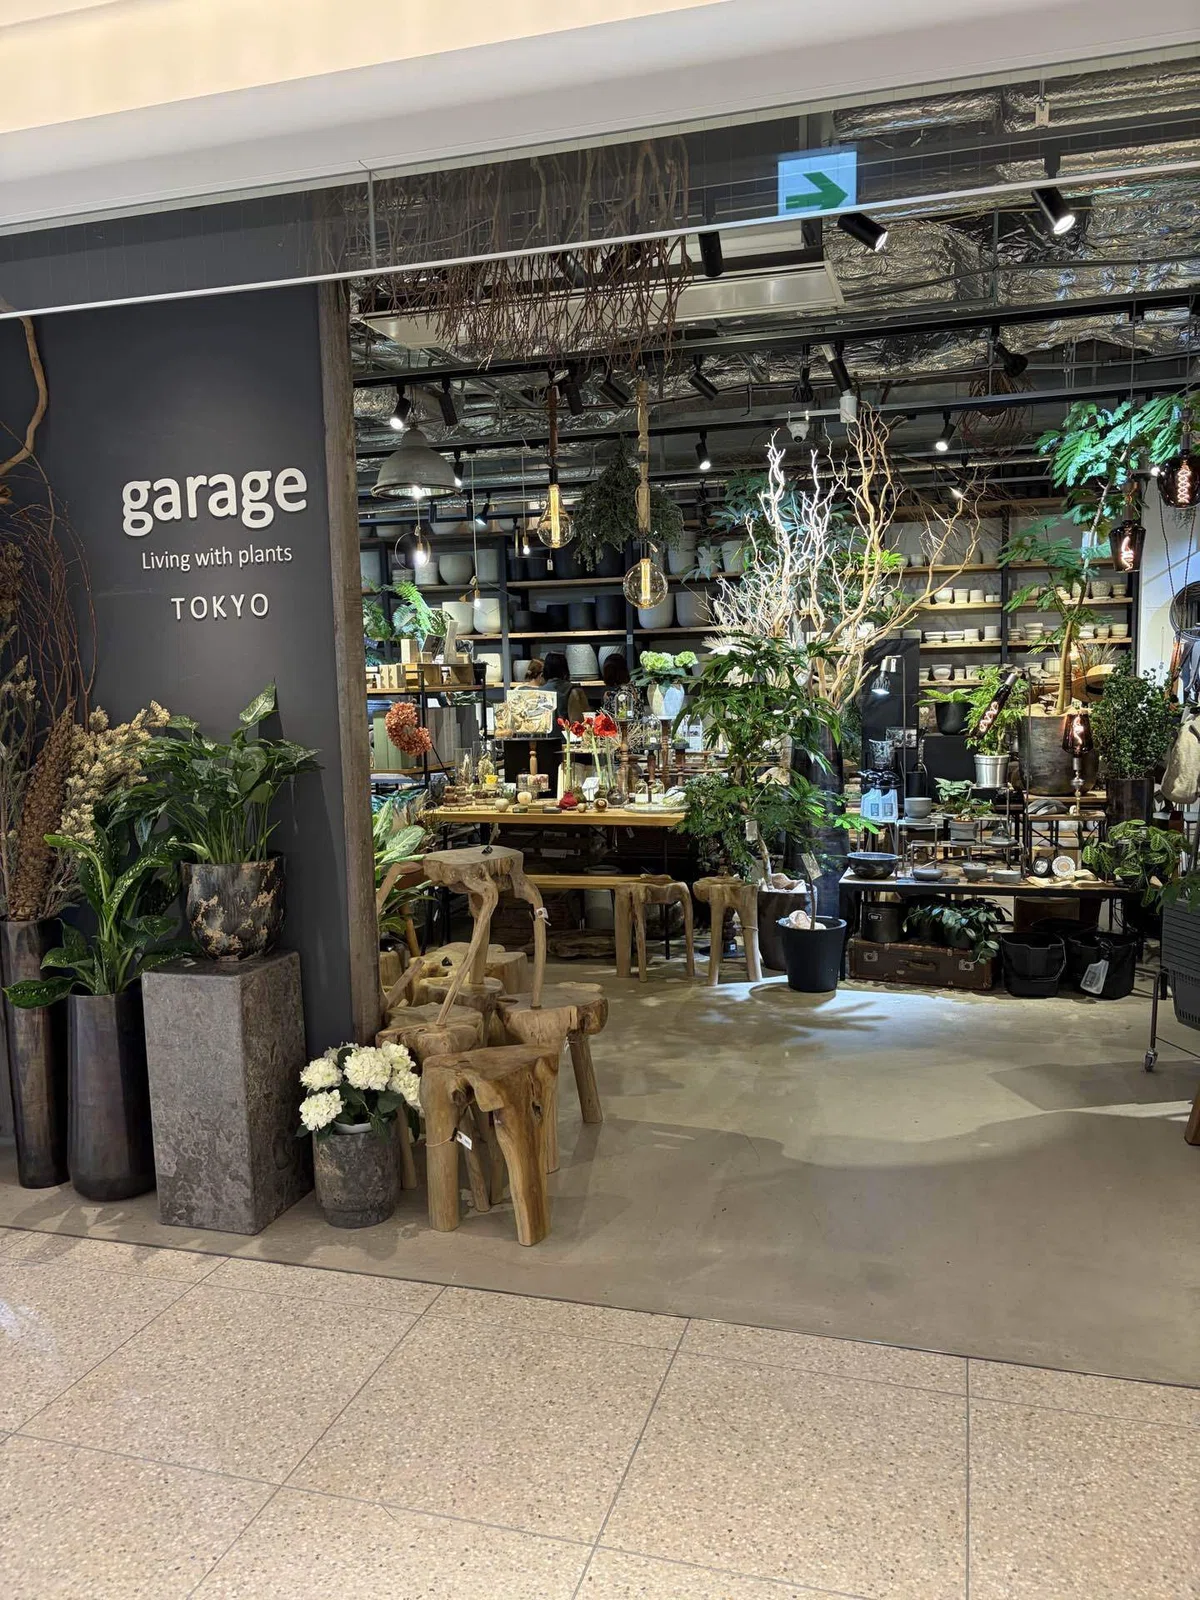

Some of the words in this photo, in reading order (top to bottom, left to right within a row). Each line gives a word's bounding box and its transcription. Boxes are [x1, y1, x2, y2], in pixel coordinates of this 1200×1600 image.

[122, 467, 307, 537] garage
[142, 551, 191, 572] Living
[195, 546, 233, 566] with
[239, 544, 293, 568] plants
[171, 593, 269, 620] TOKYO
